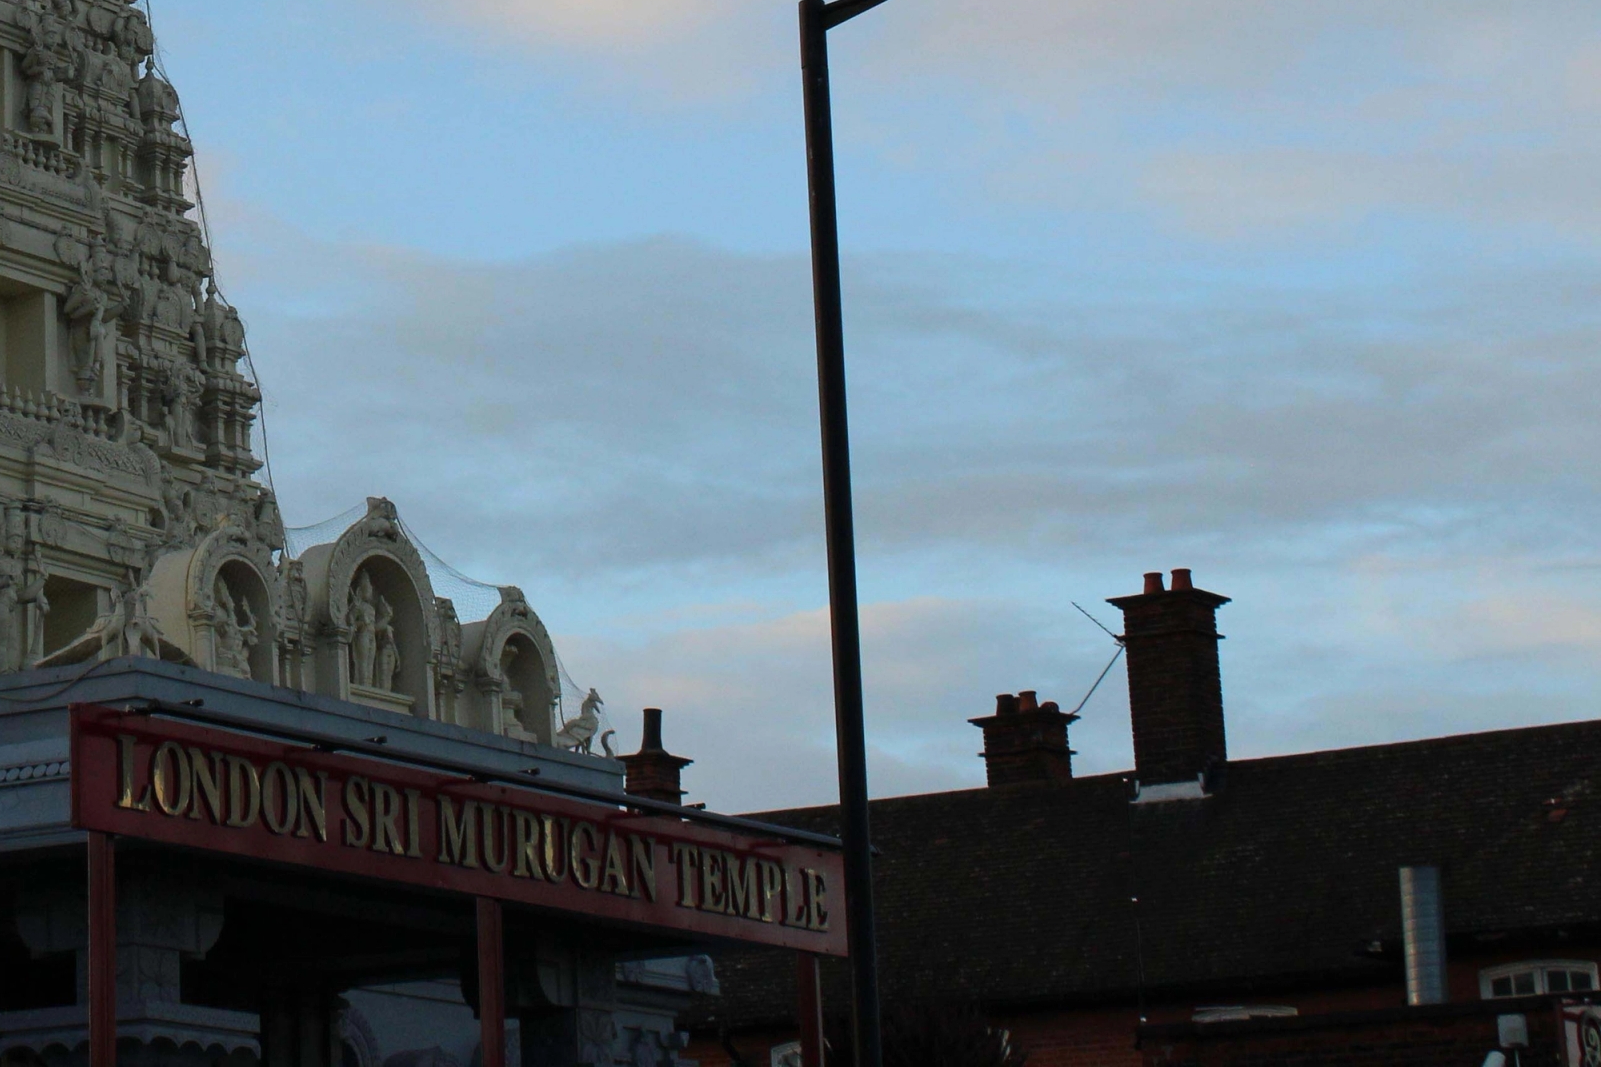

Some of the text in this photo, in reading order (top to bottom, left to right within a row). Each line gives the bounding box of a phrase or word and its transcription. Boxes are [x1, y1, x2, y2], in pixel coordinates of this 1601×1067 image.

[117, 734, 829, 931] LONDON SRI MURUGAN TEMPLE
